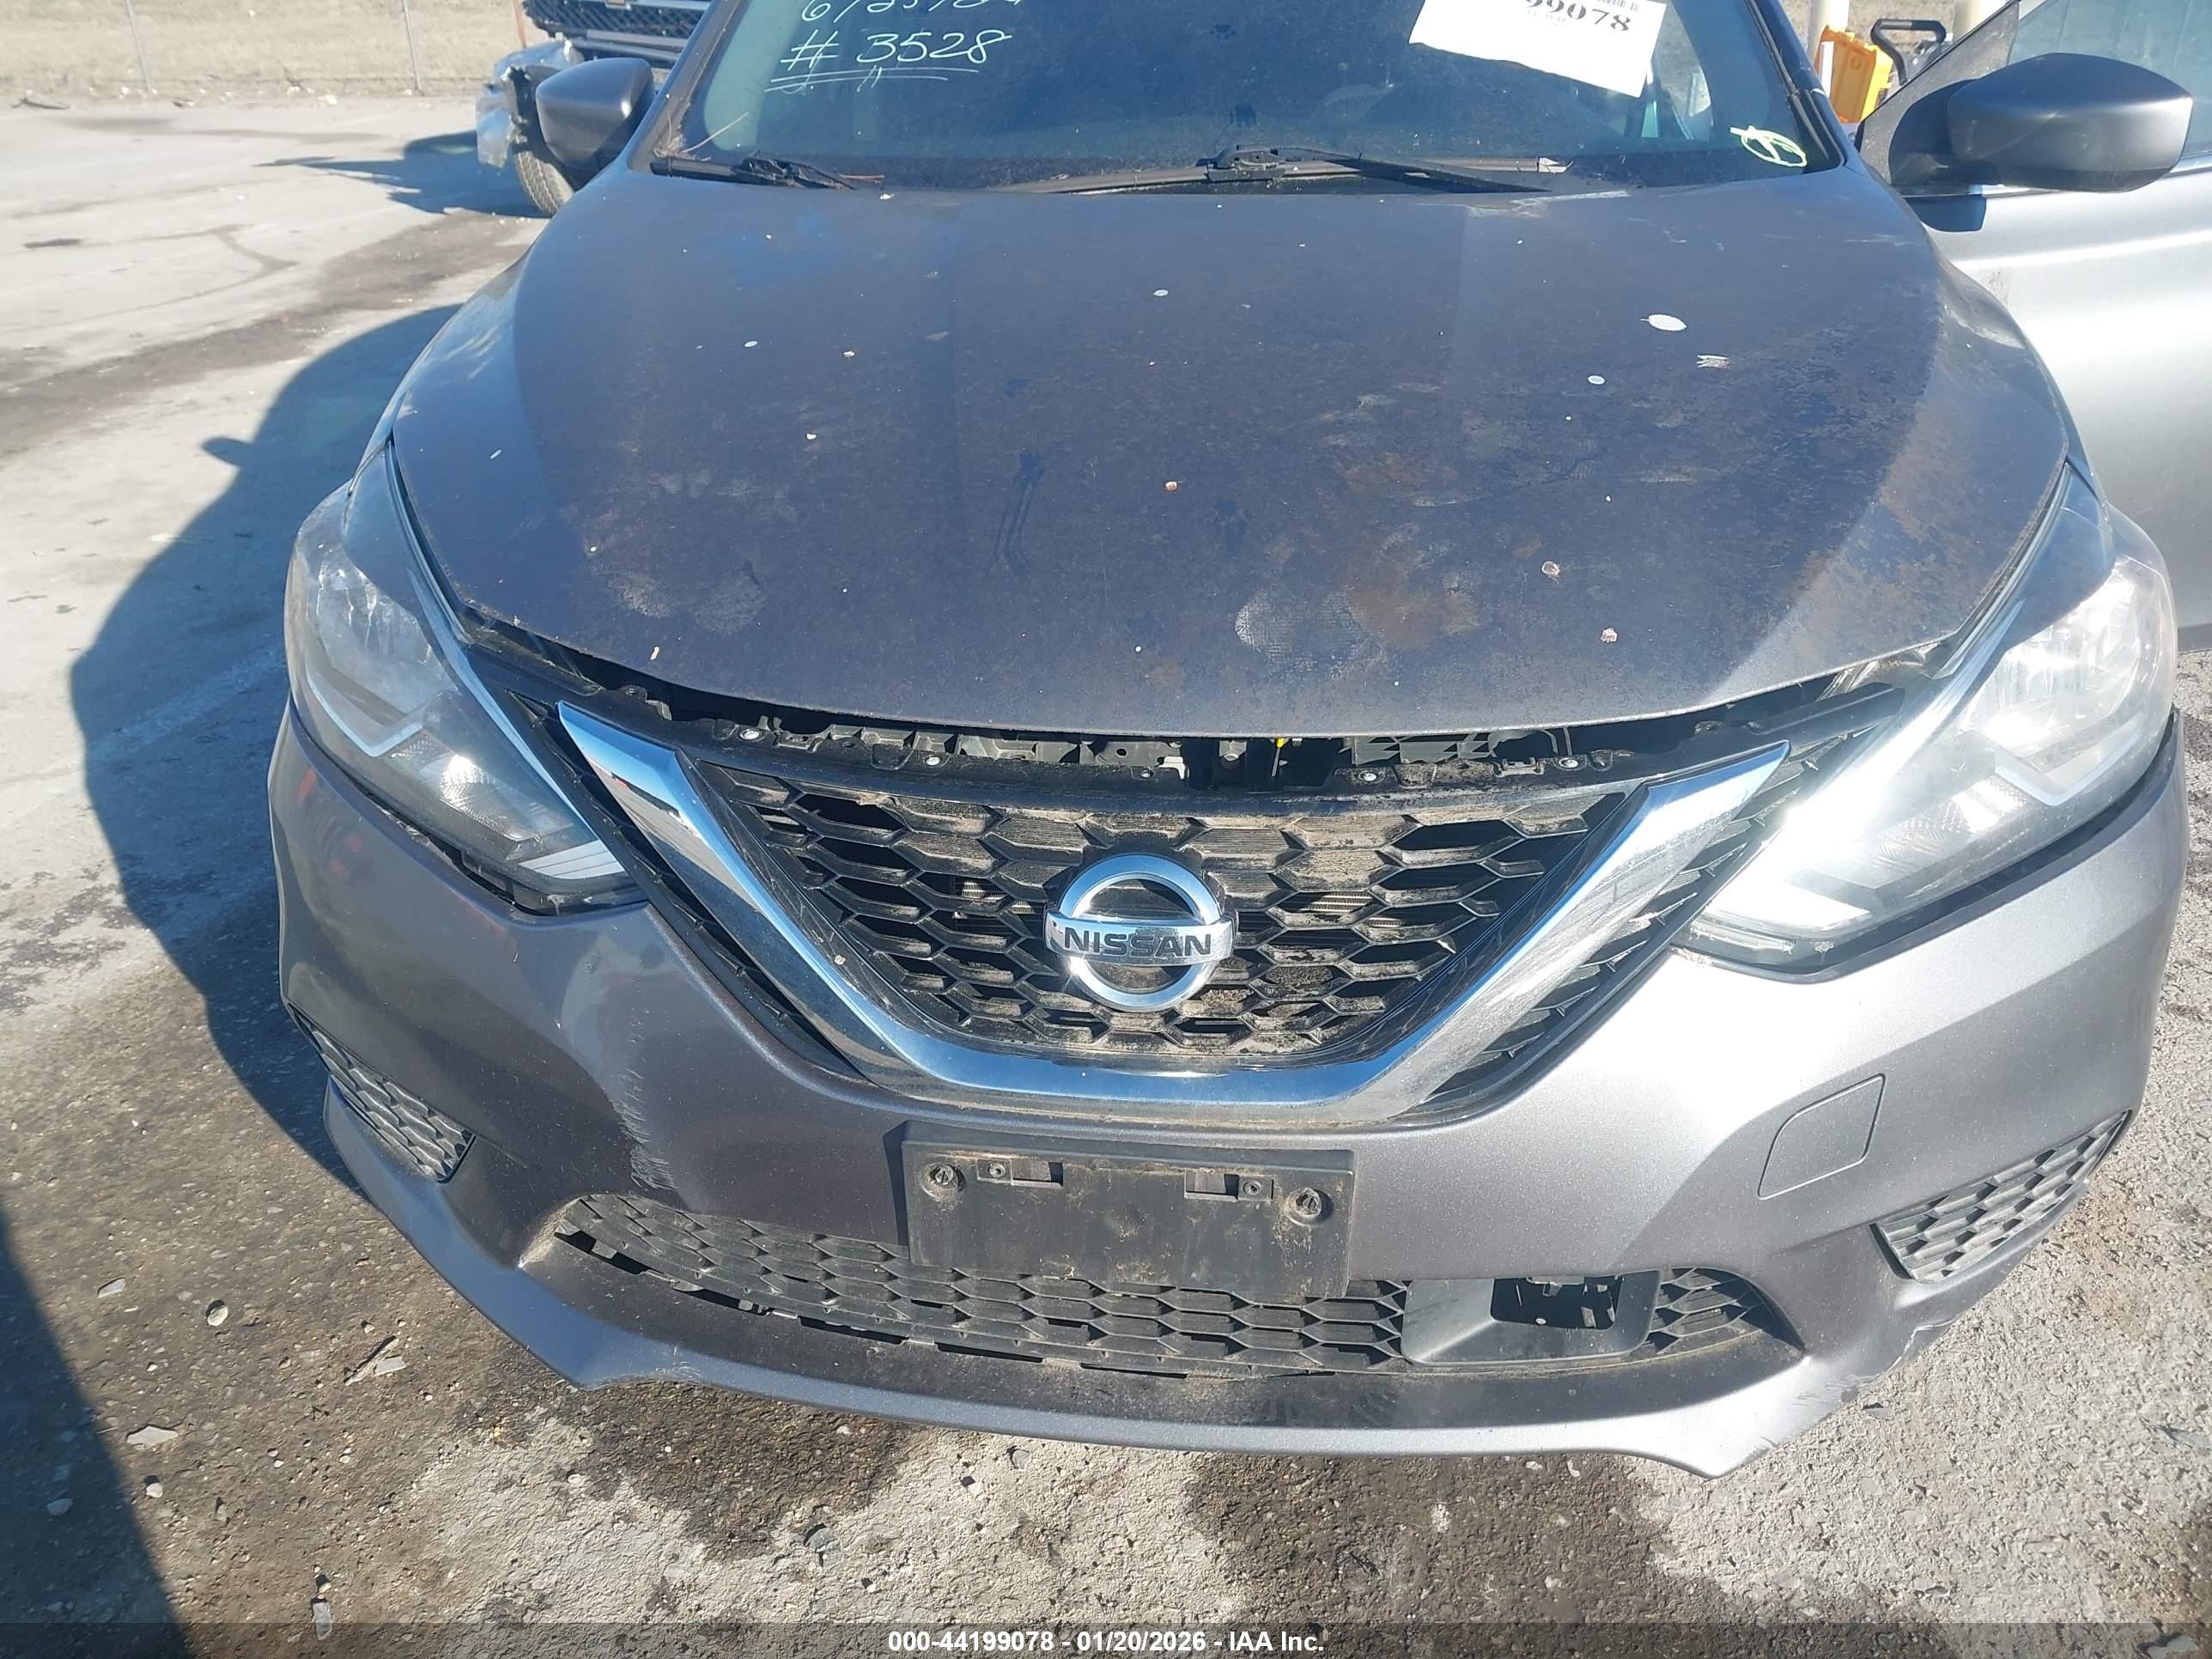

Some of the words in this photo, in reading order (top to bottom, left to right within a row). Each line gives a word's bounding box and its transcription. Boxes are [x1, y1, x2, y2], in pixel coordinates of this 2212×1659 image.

[780, 29, 840, 70] #
[856, 29, 1012, 64] 3528
[1064, 927, 1212, 957] NISSAN
